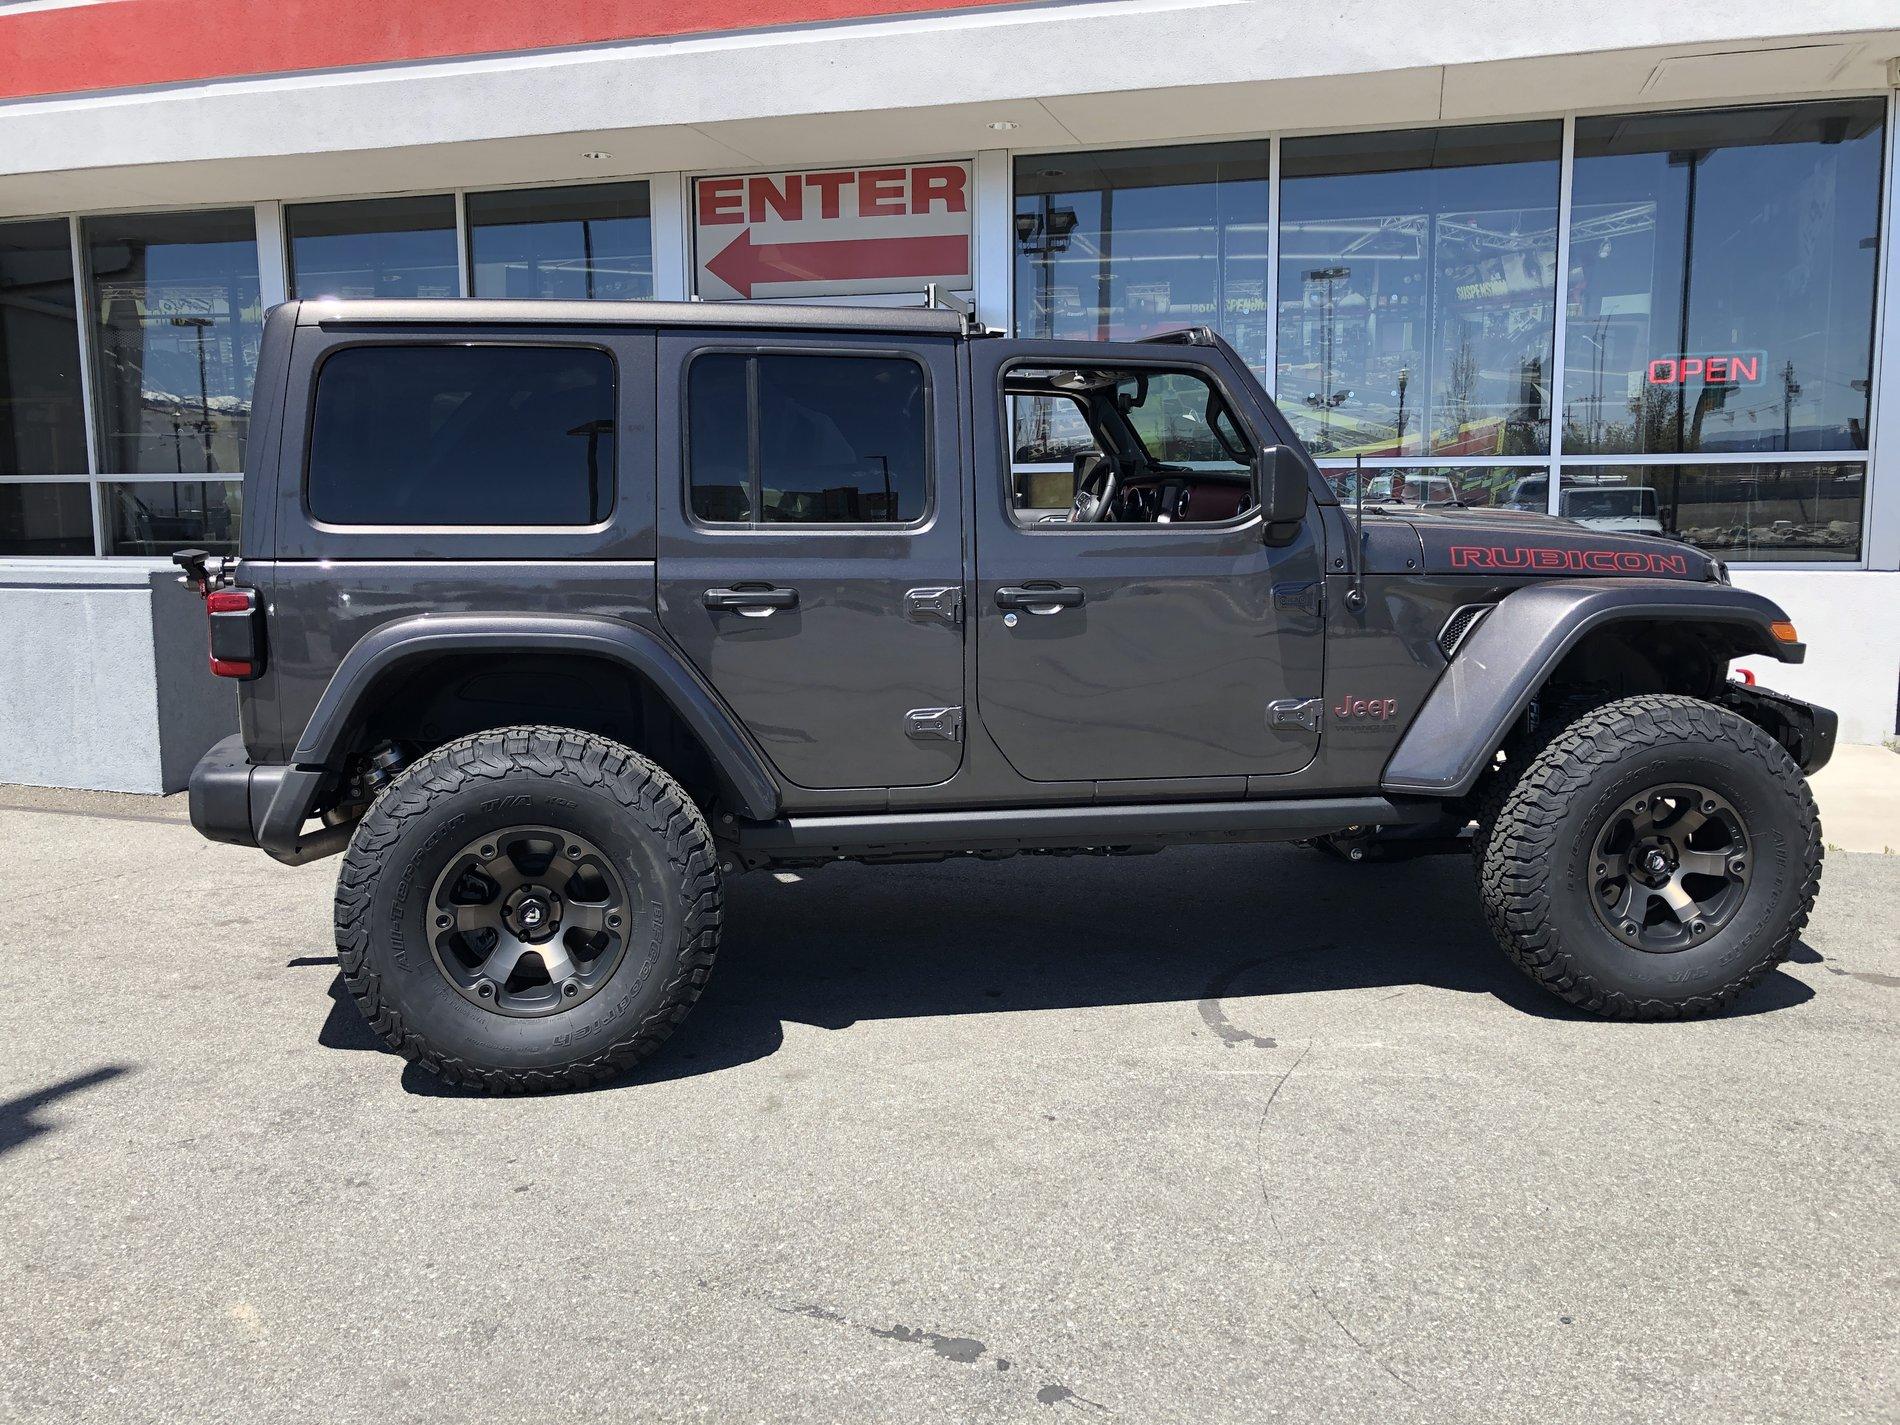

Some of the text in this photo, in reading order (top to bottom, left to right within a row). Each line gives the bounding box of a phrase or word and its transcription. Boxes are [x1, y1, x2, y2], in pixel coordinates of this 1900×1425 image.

[699, 165, 967, 226] ENTER
[1648, 357, 1758, 385] OPEN
[1449, 546, 1687, 575] RUBICON
[1334, 694, 1399, 720] Jeep
